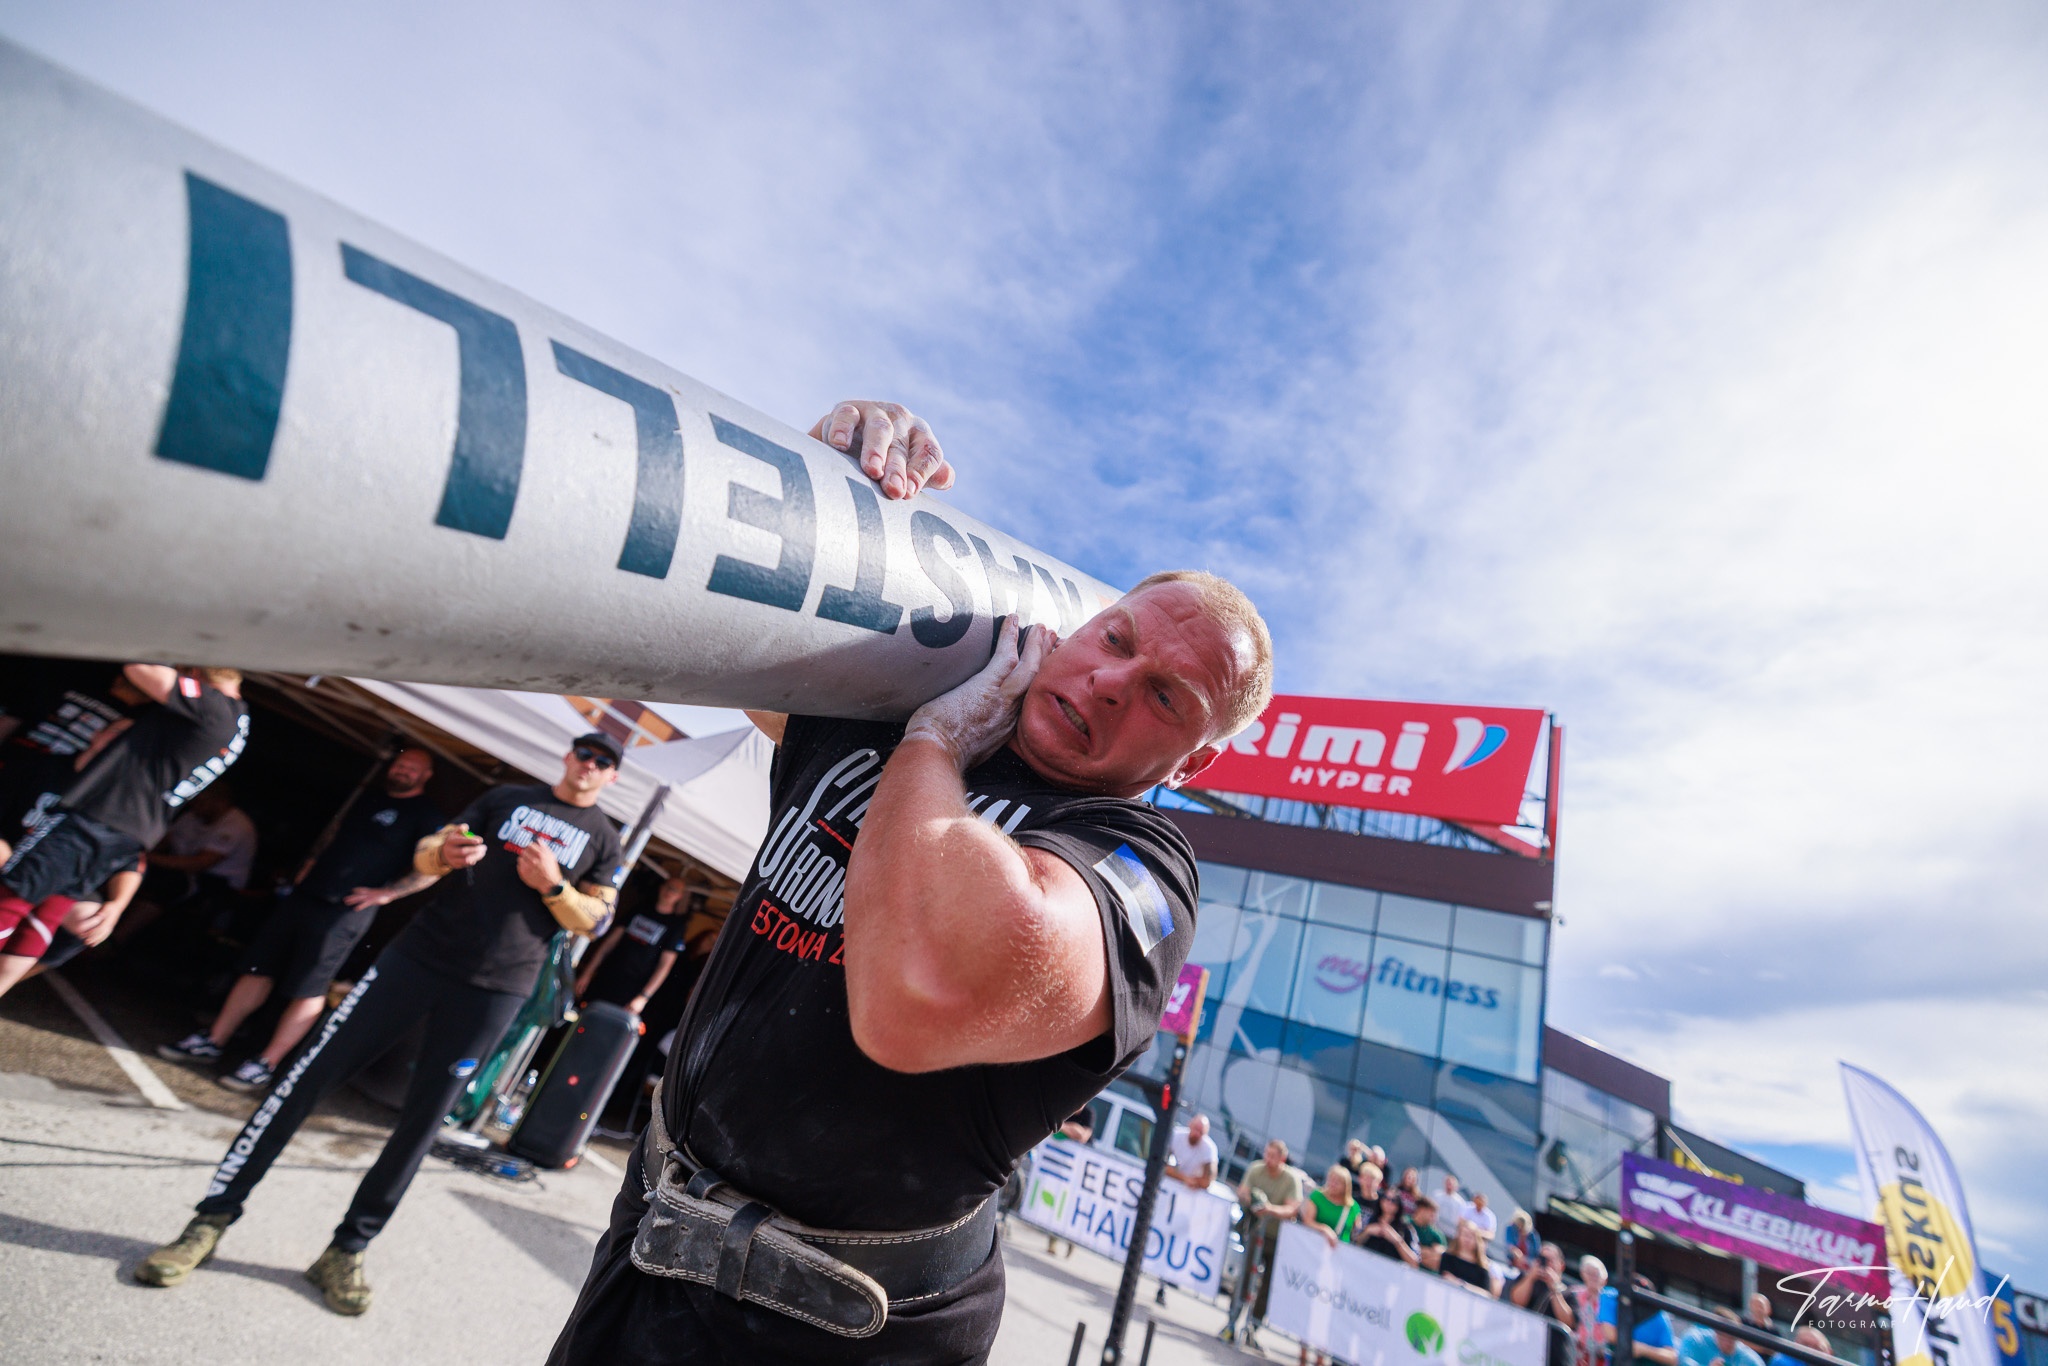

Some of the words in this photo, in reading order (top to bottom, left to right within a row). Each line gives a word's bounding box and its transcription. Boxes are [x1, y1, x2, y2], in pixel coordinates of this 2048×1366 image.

[1289, 765, 1413, 797] HYPER
[1081, 1160, 1177, 1223] EESI
[1689, 1193, 1877, 1267] KLEEBIKUM
